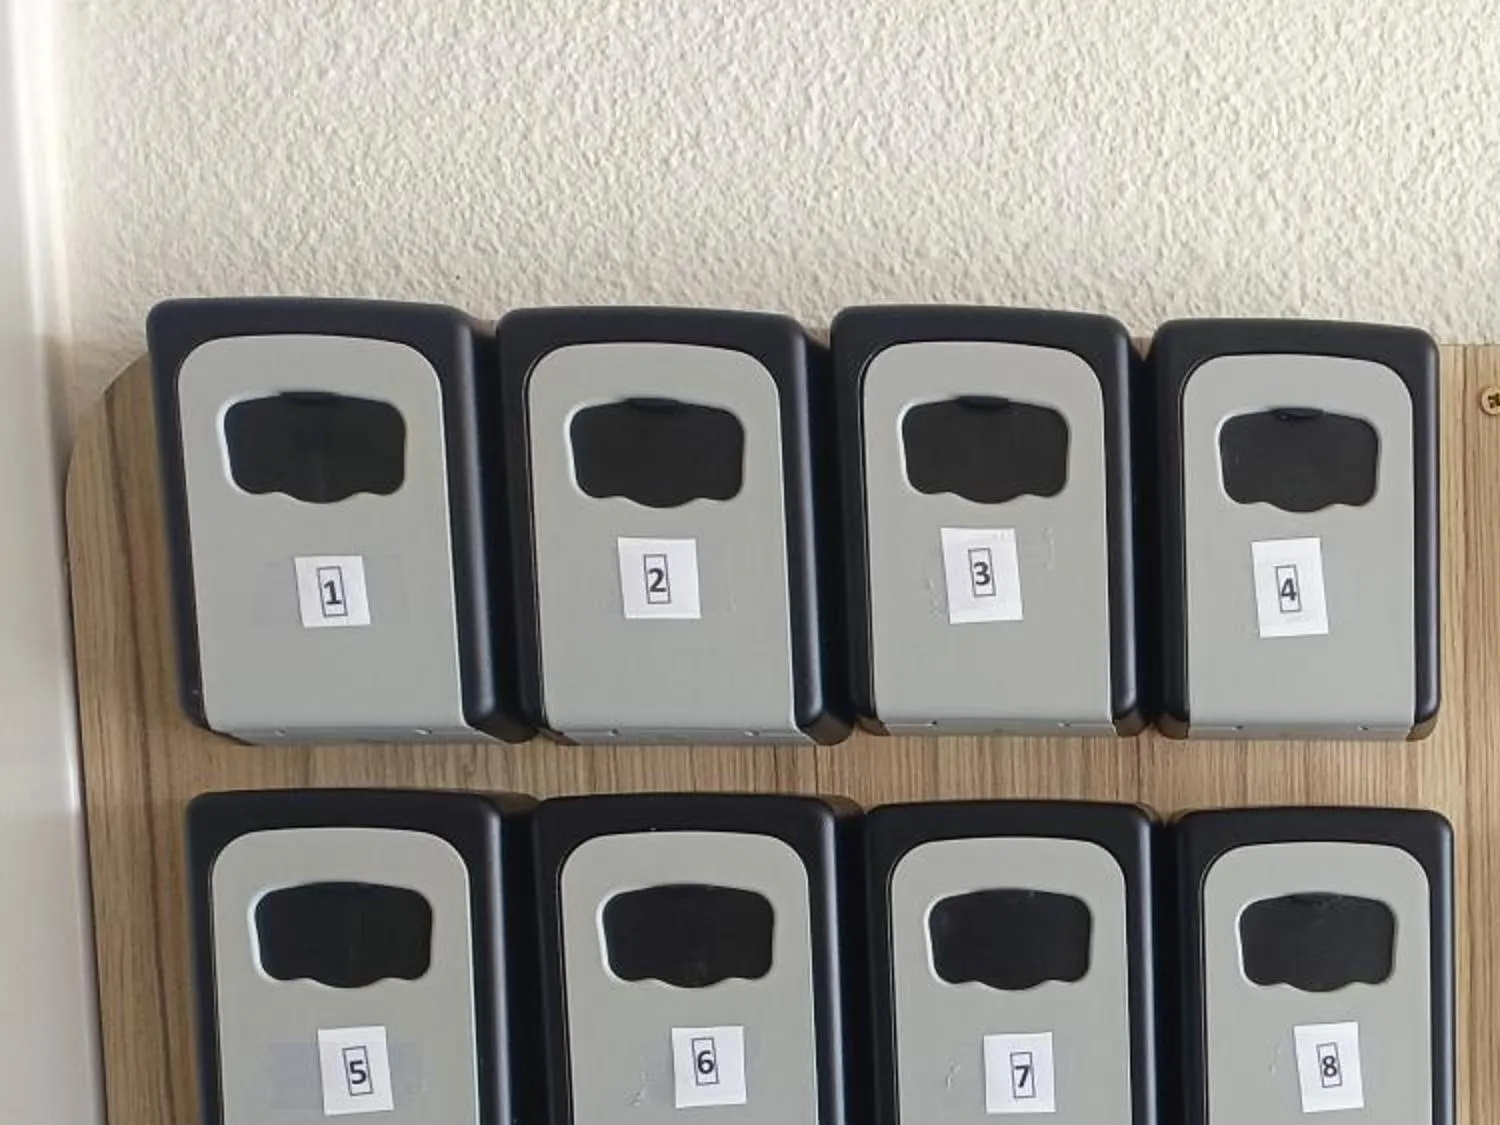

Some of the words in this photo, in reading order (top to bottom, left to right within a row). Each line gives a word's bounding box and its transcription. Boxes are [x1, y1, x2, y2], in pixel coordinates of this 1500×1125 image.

[648, 567, 667, 593] 2
[973, 561, 991, 586] 3
[323, 580, 342, 605] 1
[1278, 578, 1297, 601] 4
[349, 1059, 367, 1085] 5
[697, 1050, 716, 1075] 6
[1322, 1055, 1338, 1078] 8
[1014, 1065, 1031, 1089] 7
